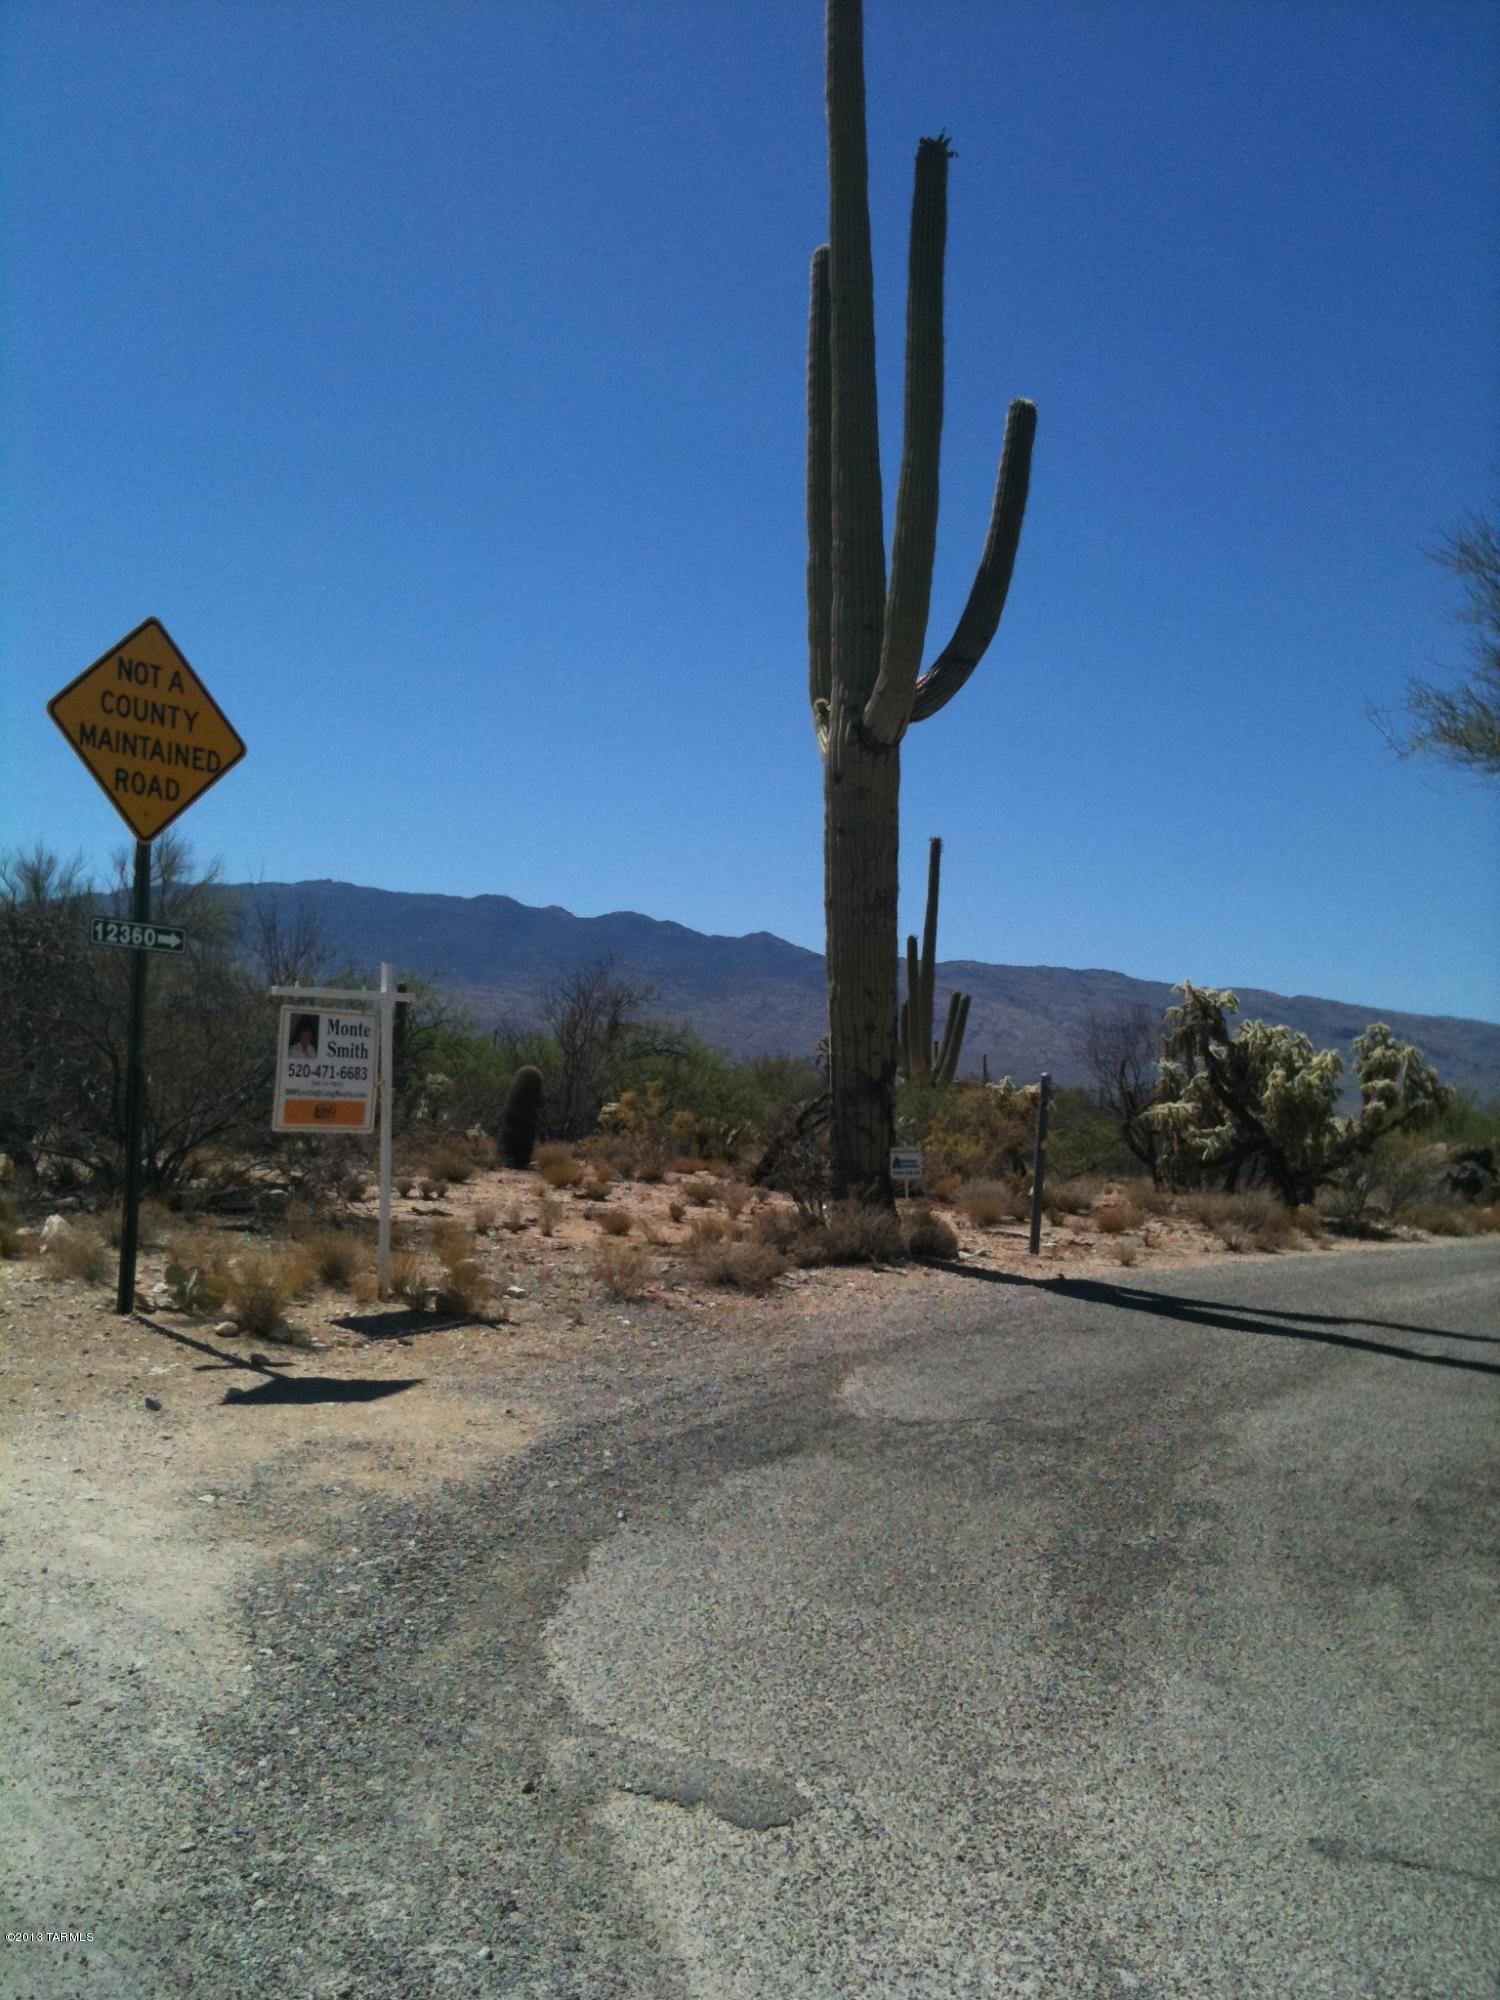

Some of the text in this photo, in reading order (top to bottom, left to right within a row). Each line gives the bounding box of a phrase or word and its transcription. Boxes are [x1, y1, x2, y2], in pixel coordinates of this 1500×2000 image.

[117, 657, 185, 694] NOT A
[100, 690, 200, 733] COUNTY
[78, 722, 222, 773] MAINTAINED
[114, 768, 181, 802] ROAD
[94, 922, 156, 947] 12360
[327, 1018, 371, 1038] Monte
[327, 1040, 369, 1060] Smith
[288, 1063, 368, 1081] 520-471-6683
